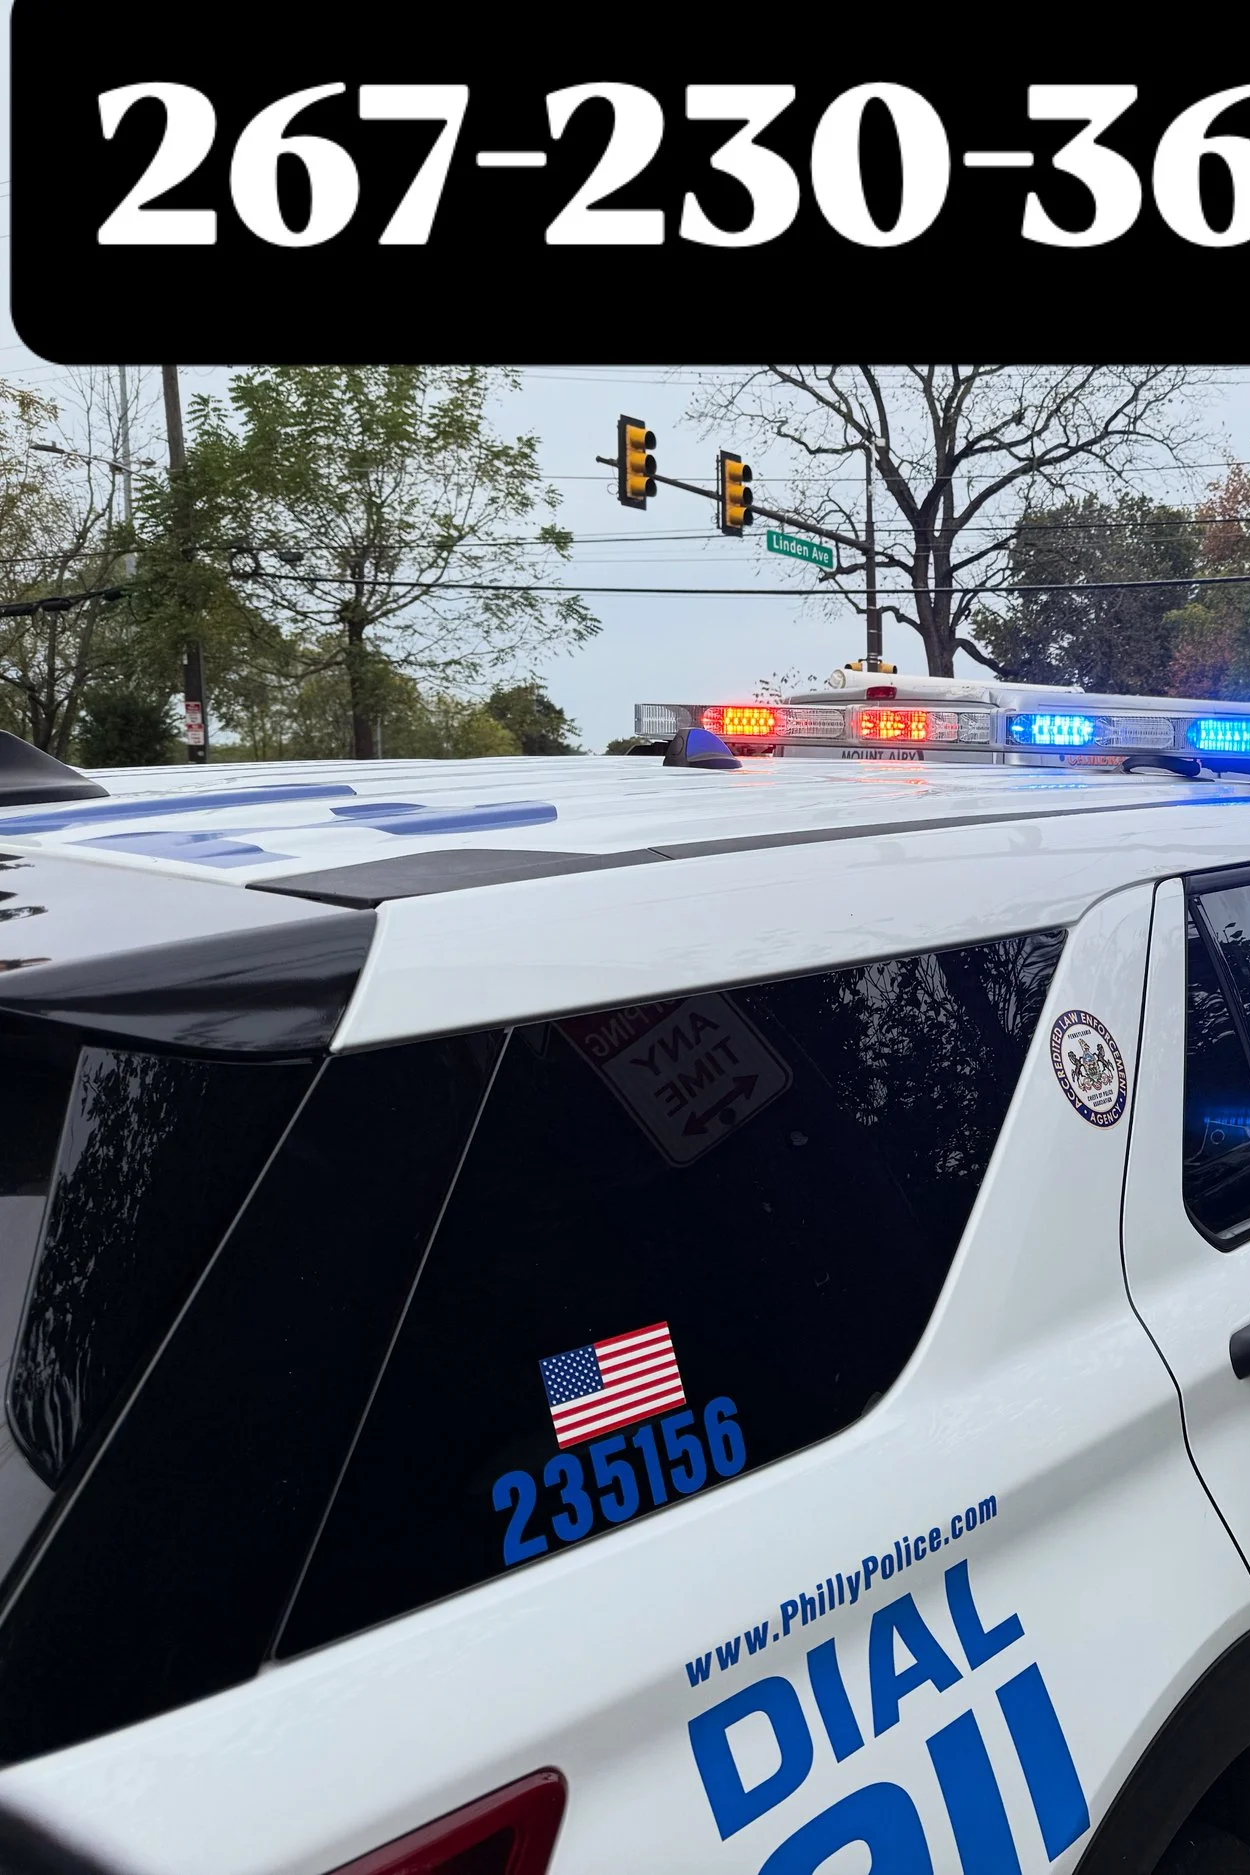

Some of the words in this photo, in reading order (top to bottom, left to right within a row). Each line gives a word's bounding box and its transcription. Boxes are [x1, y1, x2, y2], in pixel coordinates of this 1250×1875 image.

[773, 534, 809, 557] Linden
[812, 547, 829, 563] Ave
[842, 750, 883, 760] MOUNT
[1059, 1012, 1078, 1031] LAW
[1080, 1013, 1127, 1097] ENFORCEMENT
[1052, 1028, 1083, 1109] ACCREDITED
[1090, 1105, 1122, 1125] AGENCY
[492, 1396, 747, 1567] 235156
[685, 1494, 998, 1688] www.PhillyPolice.com
[688, 1557, 1026, 1841] DIAL
